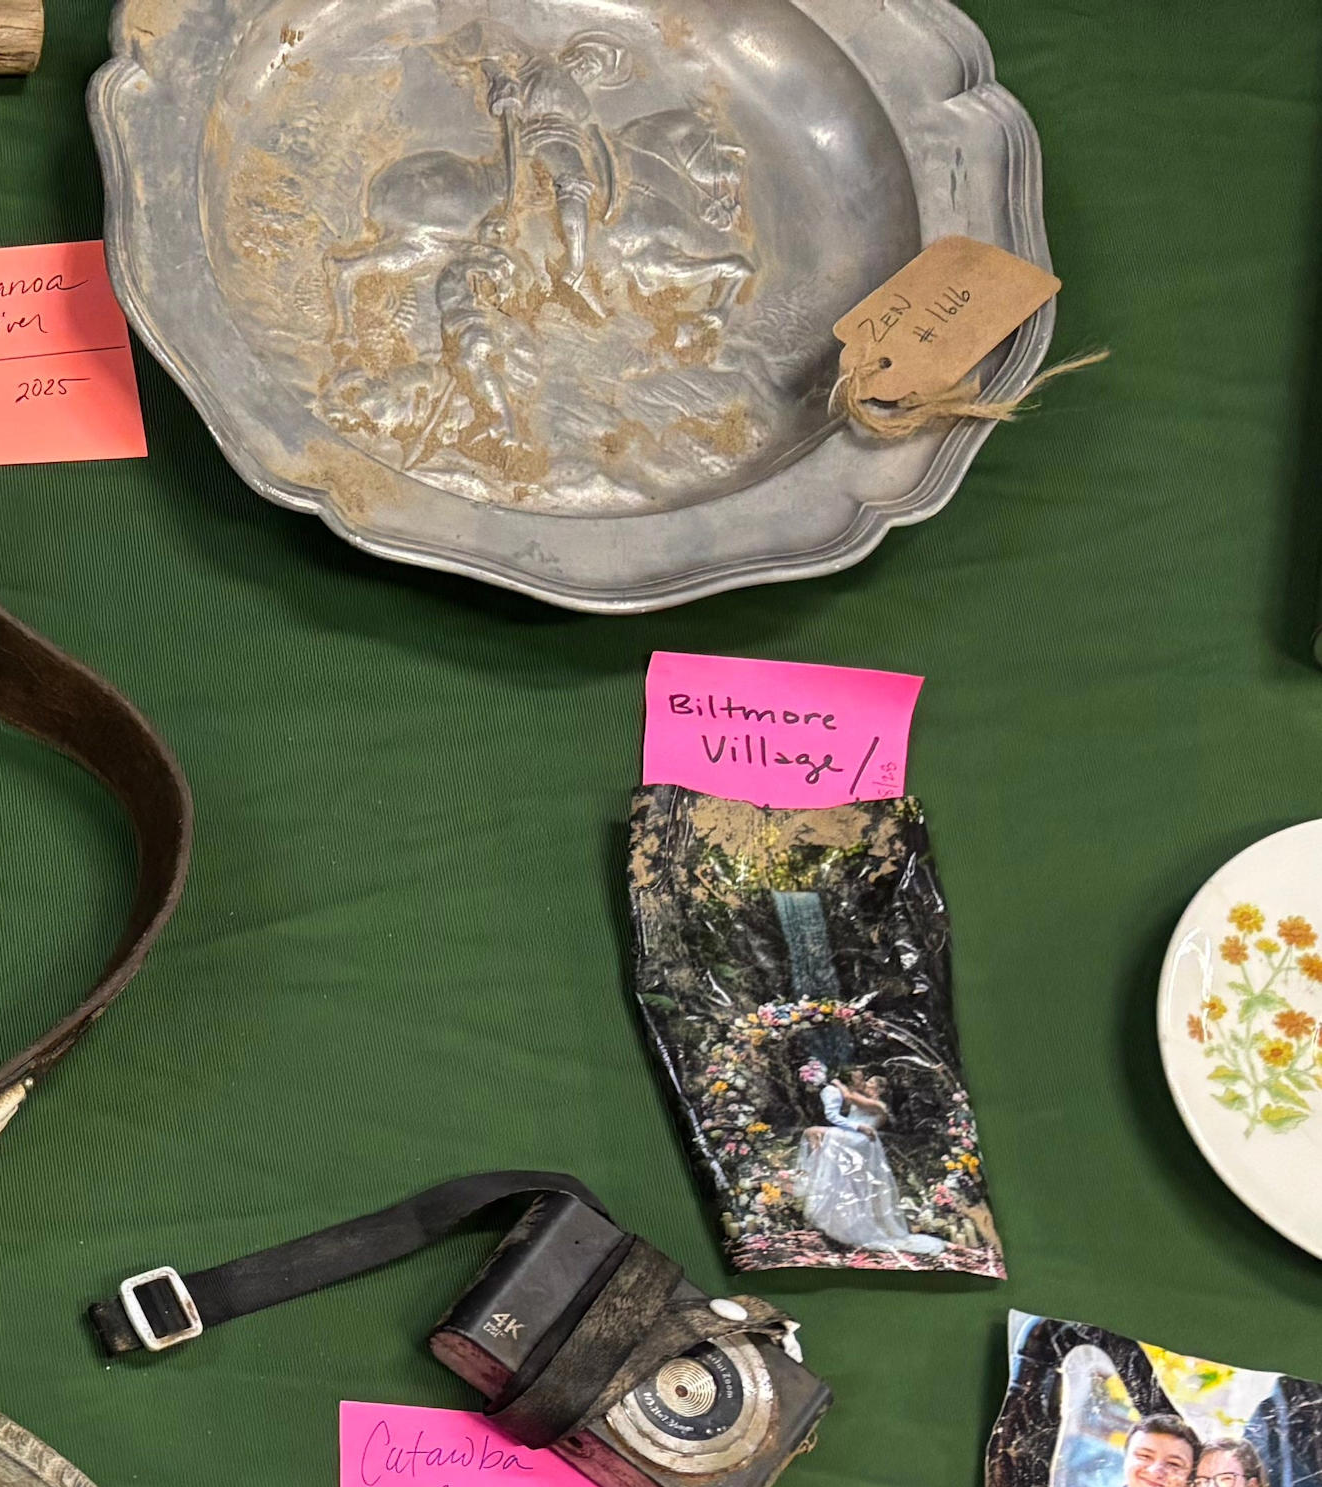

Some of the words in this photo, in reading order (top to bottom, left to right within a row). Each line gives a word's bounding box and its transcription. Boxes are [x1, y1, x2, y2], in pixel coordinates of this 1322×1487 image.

[858, 293, 912, 343] ZEN
[15, 377, 91, 404] 2025
[669, 694, 837, 730] Biltmore
[491, 1313, 525, 1340] 4K
[361, 1420, 534, 1487] Catawba
